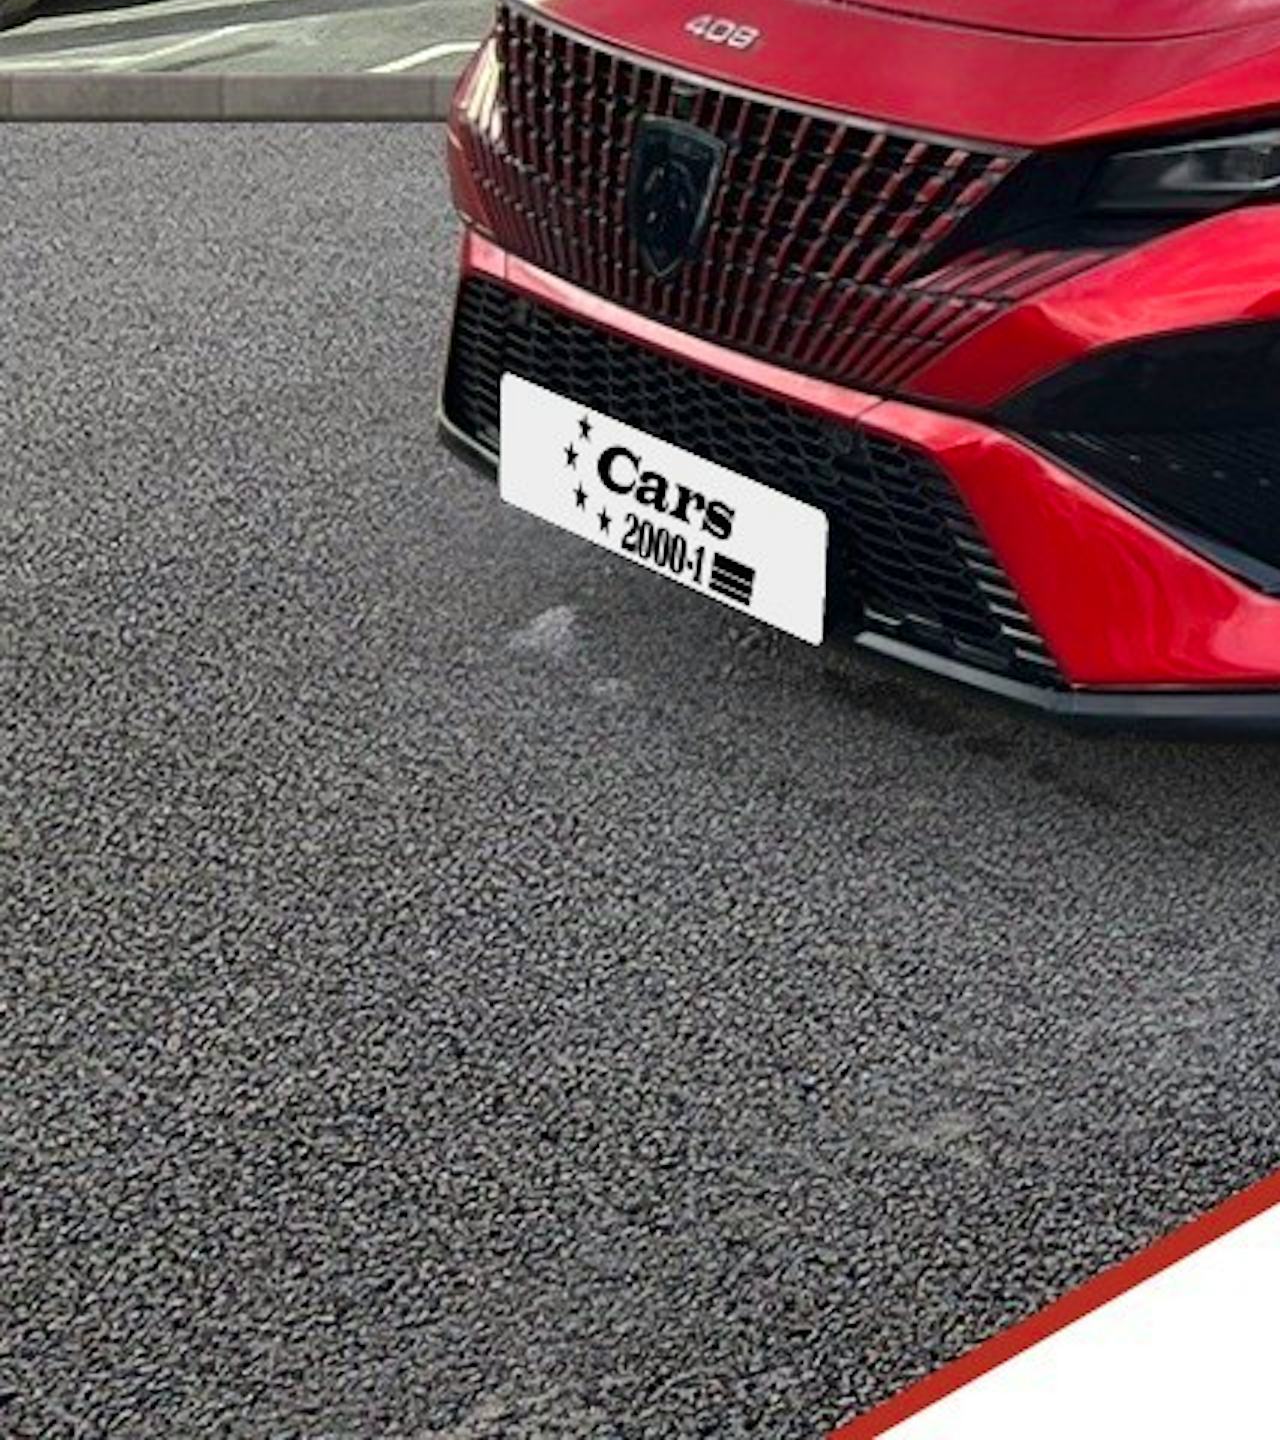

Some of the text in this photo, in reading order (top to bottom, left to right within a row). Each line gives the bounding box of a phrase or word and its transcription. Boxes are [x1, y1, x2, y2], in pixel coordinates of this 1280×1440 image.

[683, 13, 761, 51] 408
[596, 446, 736, 540] Cars
[620, 512, 706, 585] 2000-1
